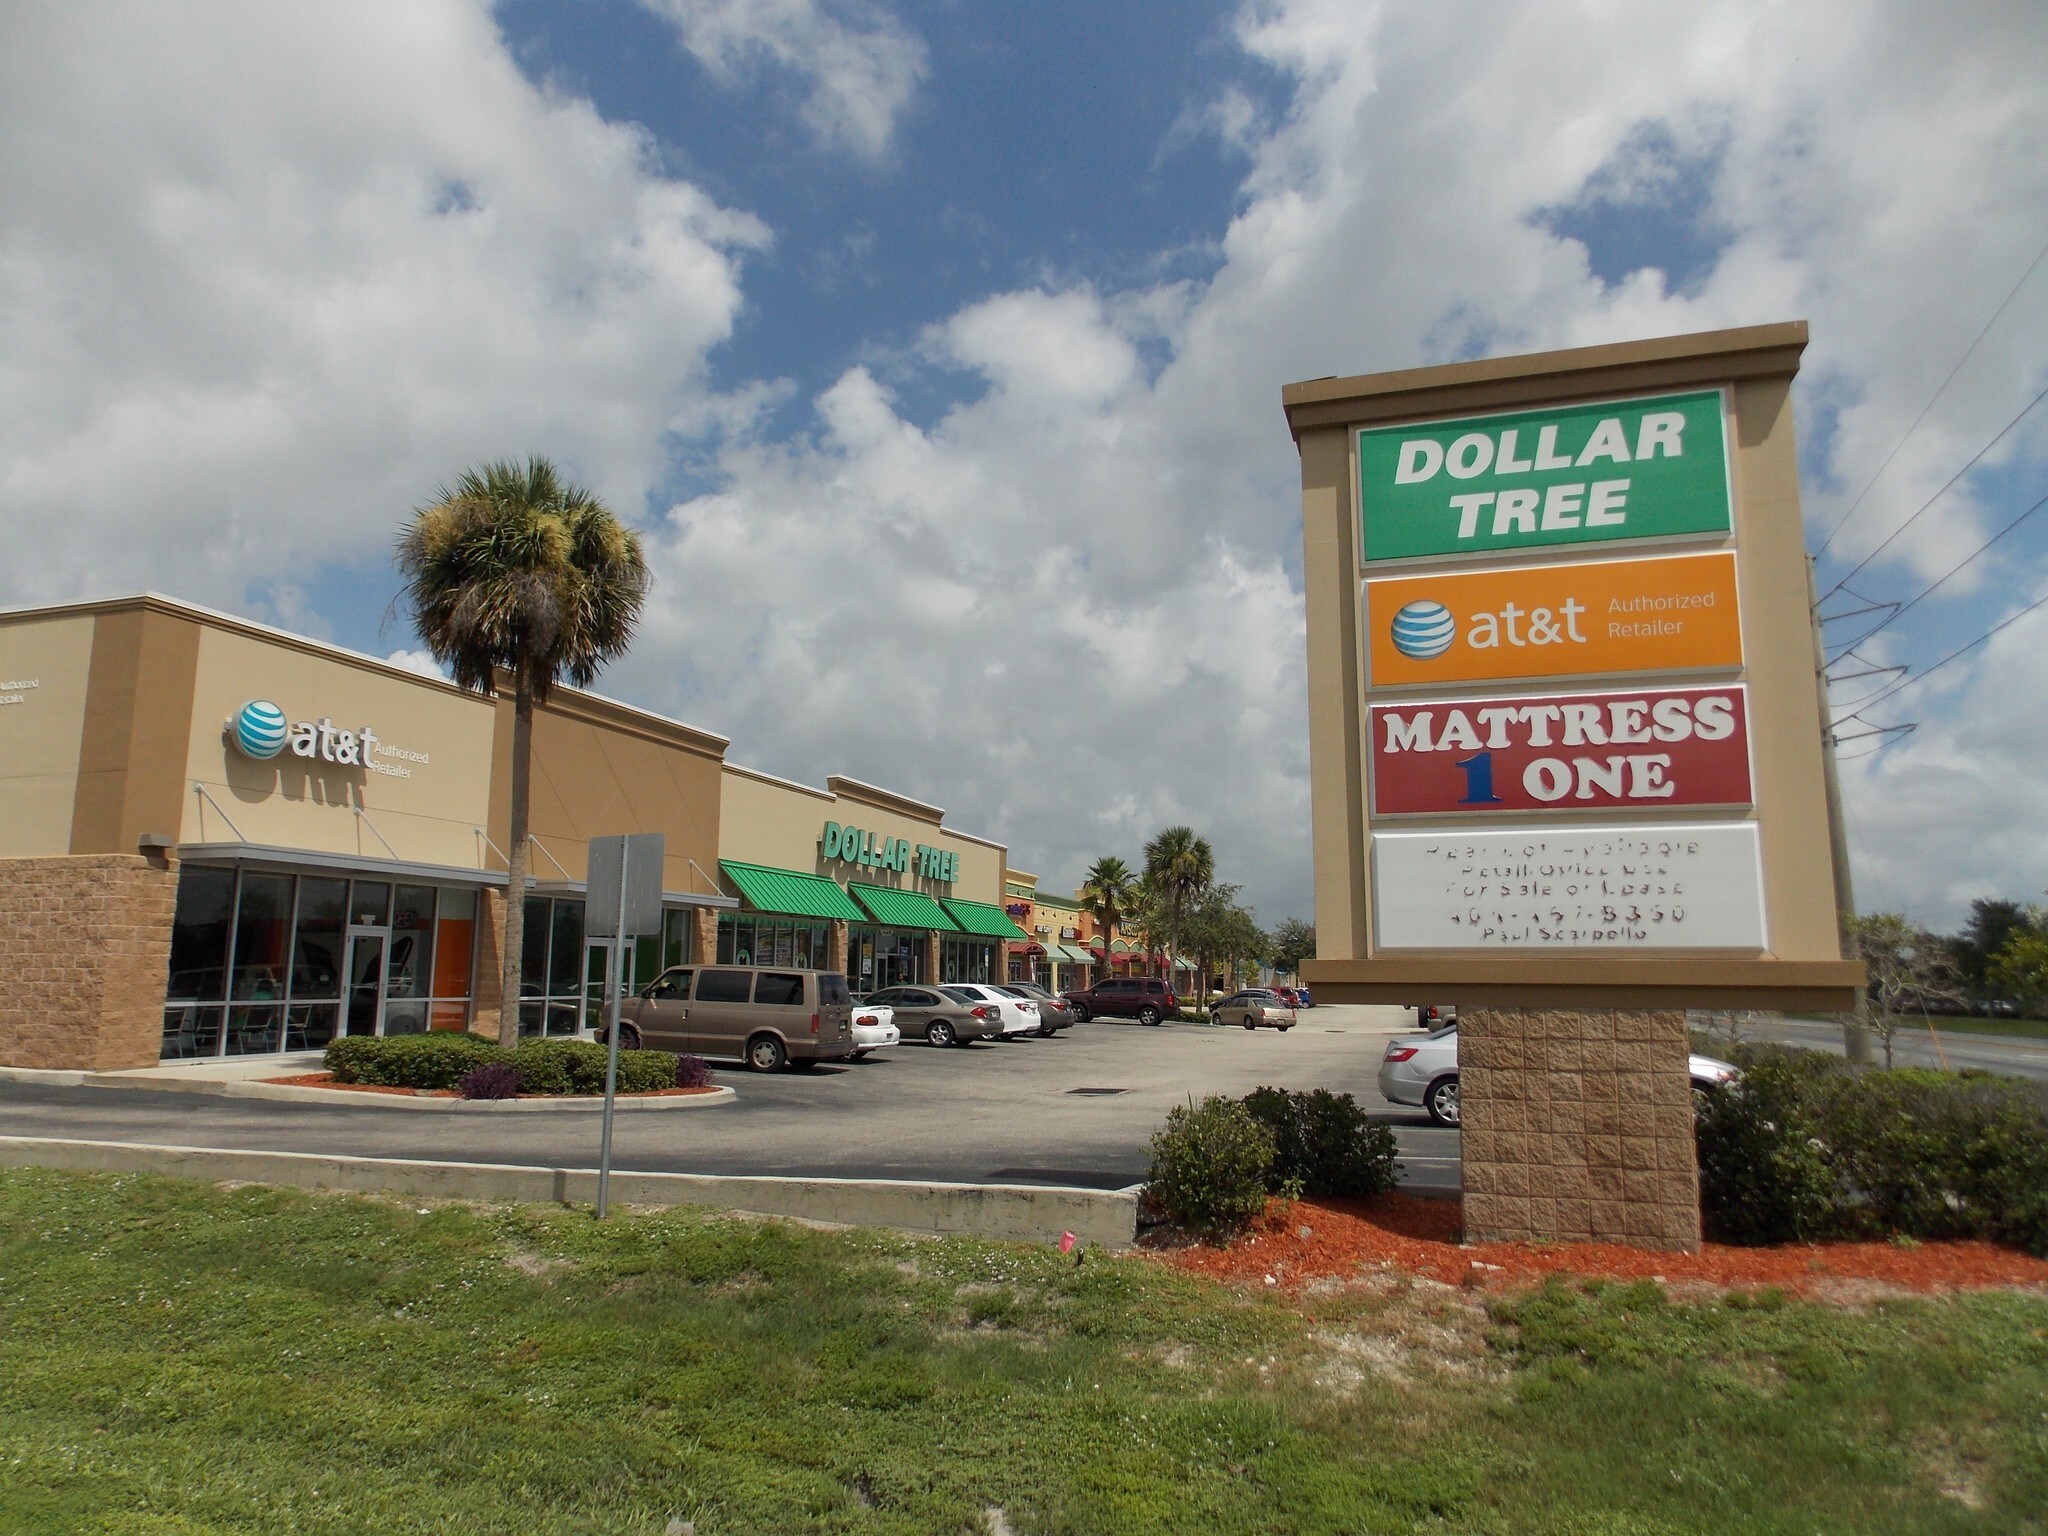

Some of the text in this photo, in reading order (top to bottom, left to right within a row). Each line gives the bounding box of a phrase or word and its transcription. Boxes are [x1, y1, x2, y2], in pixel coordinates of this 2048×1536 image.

[1394, 412, 1686, 485] DOLLAR
[1449, 479, 1631, 539] TREE
[1467, 597, 1587, 649] at&t
[1607, 591, 1715, 615] Authorized
[1608, 620, 1684, 639] Retailer
[290, 717, 378, 769] at&t
[1383, 696, 1735, 753] MATTRESS
[373, 760, 412, 779] Retailer
[374, 741, 429, 764] Authorized
[1455, 752, 1675, 803] 1 ONE
[823, 821, 910, 874] DOLLAR
[916, 844, 960, 884] TREE
